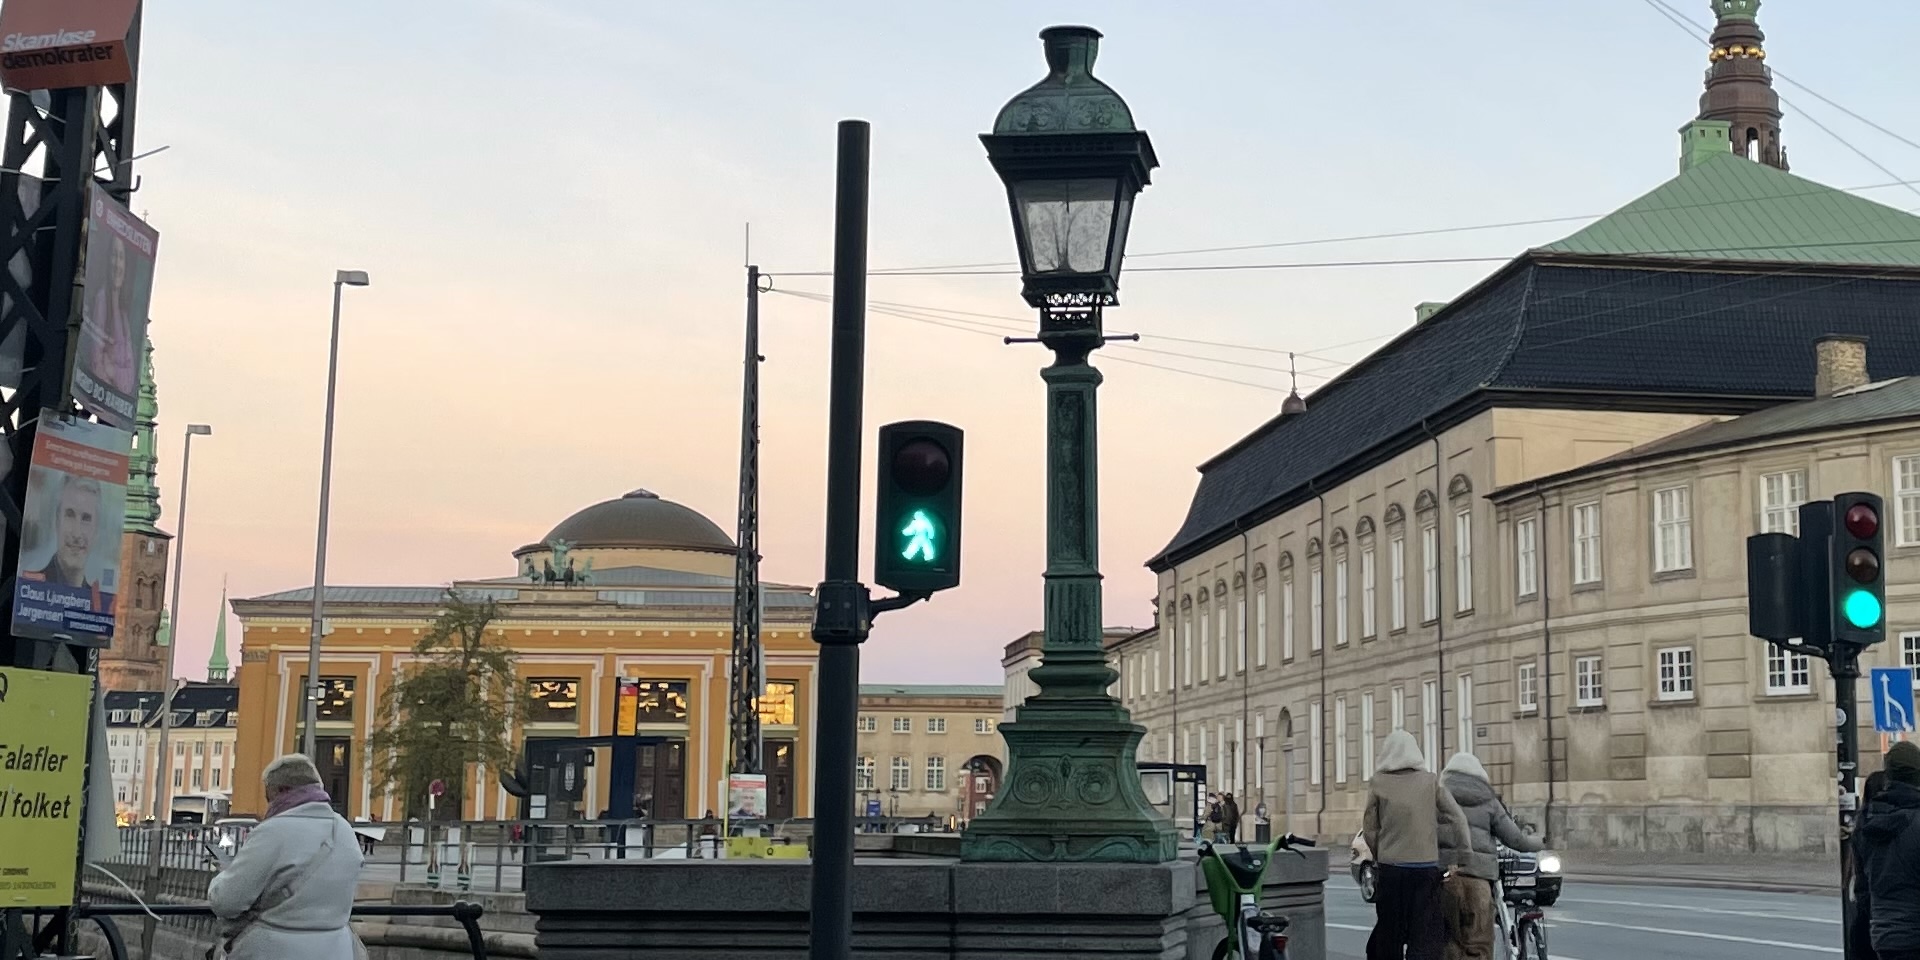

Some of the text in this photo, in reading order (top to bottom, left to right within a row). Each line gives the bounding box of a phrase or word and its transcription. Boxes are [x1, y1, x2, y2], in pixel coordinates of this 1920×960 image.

[2, 44, 114, 70] demokrater
[20, 584, 91, 611] Claus Ljungberg
[12, 792, 71, 818] folket
